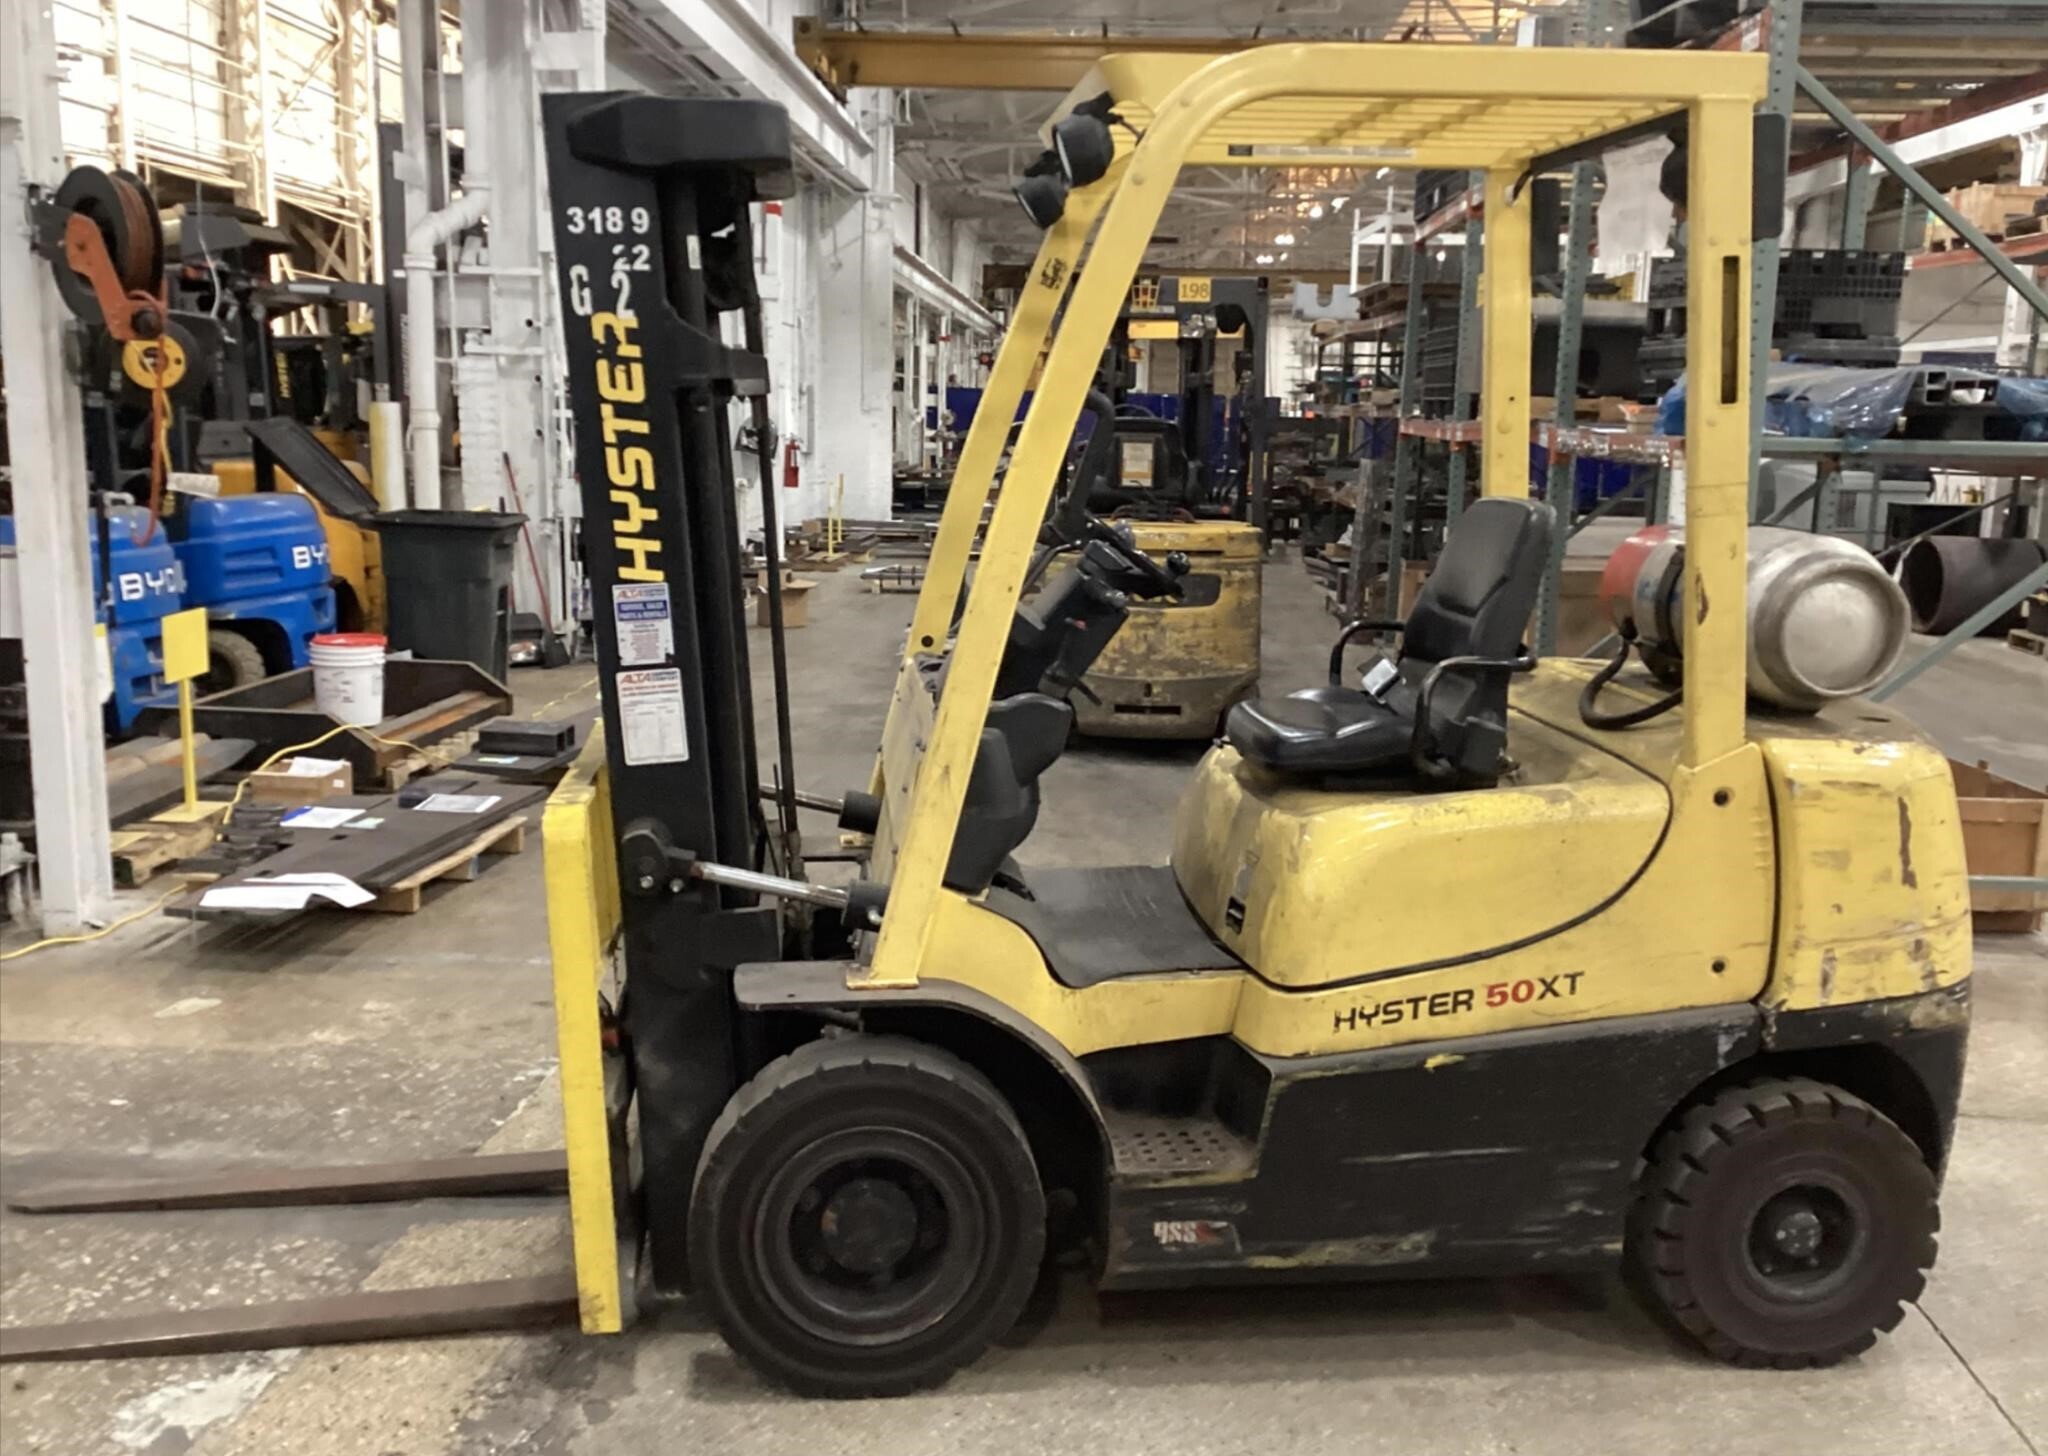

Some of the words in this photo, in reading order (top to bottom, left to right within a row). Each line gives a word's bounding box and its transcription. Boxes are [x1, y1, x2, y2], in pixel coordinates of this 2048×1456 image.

[566, 206, 649, 234] 3189
[1180, 282, 1210, 299] 198
[591, 311, 664, 582] HYSTER
[621, 673, 650, 684] ALTA
[1333, 989, 1475, 1033] HYSTER
[1485, 971, 1585, 1008] 50XT
